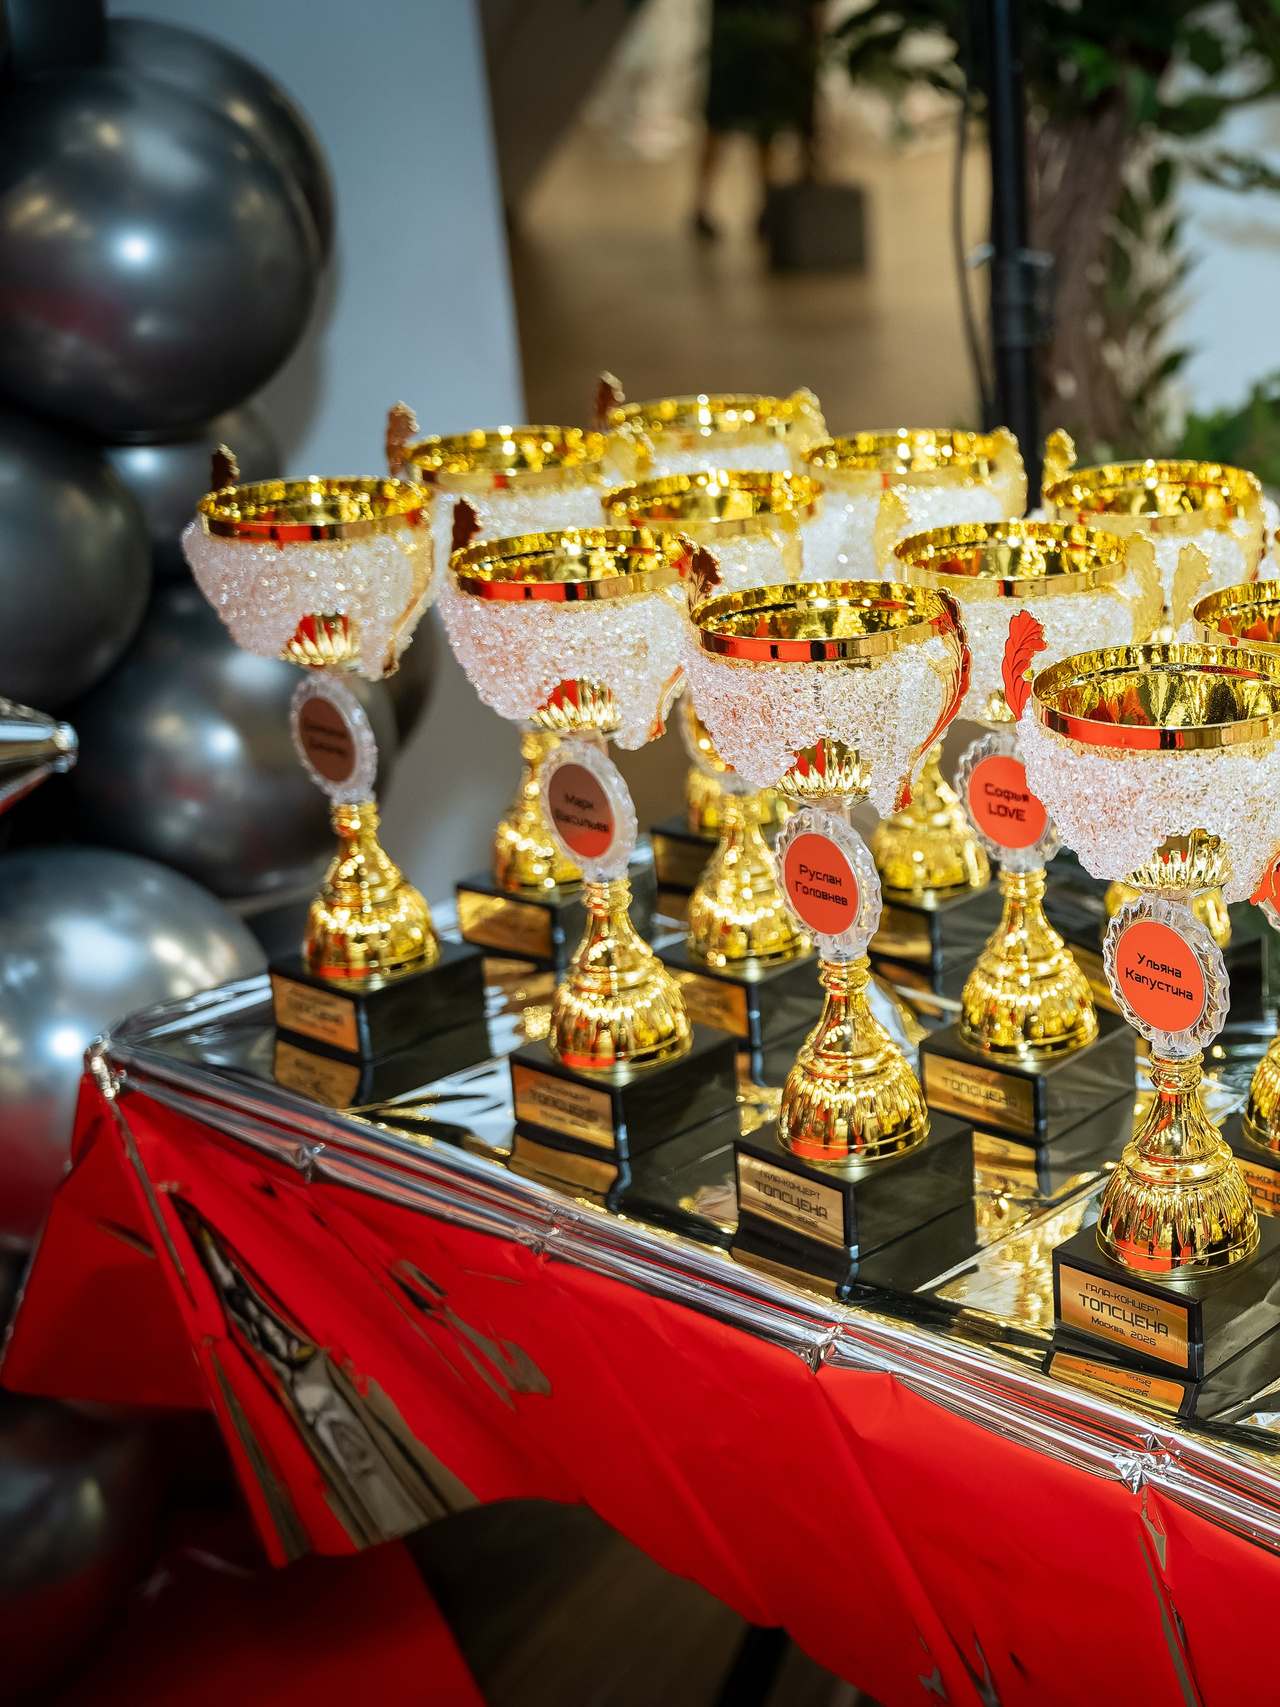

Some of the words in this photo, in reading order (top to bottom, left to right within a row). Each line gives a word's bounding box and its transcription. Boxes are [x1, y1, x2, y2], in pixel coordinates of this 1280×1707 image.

[989, 802, 1026, 821] LOVE
[799, 864, 842, 886] Руслан
[795, 880, 848, 906] Головнев
[1137, 952, 1182, 978] Ульяна
[1125, 967, 1193, 1001] Капустина
[755, 1180, 828, 1219] ТОПСЦЕНА
[1079, 1293, 1169, 1337] ТОПСЦЕНА
[1085, 1282, 1161, 1316] ГАЛА-КОНЦЕРТ
[1091, 1315, 1126, 1337] Москва,
[1130, 1330, 1157, 1347] 2026
